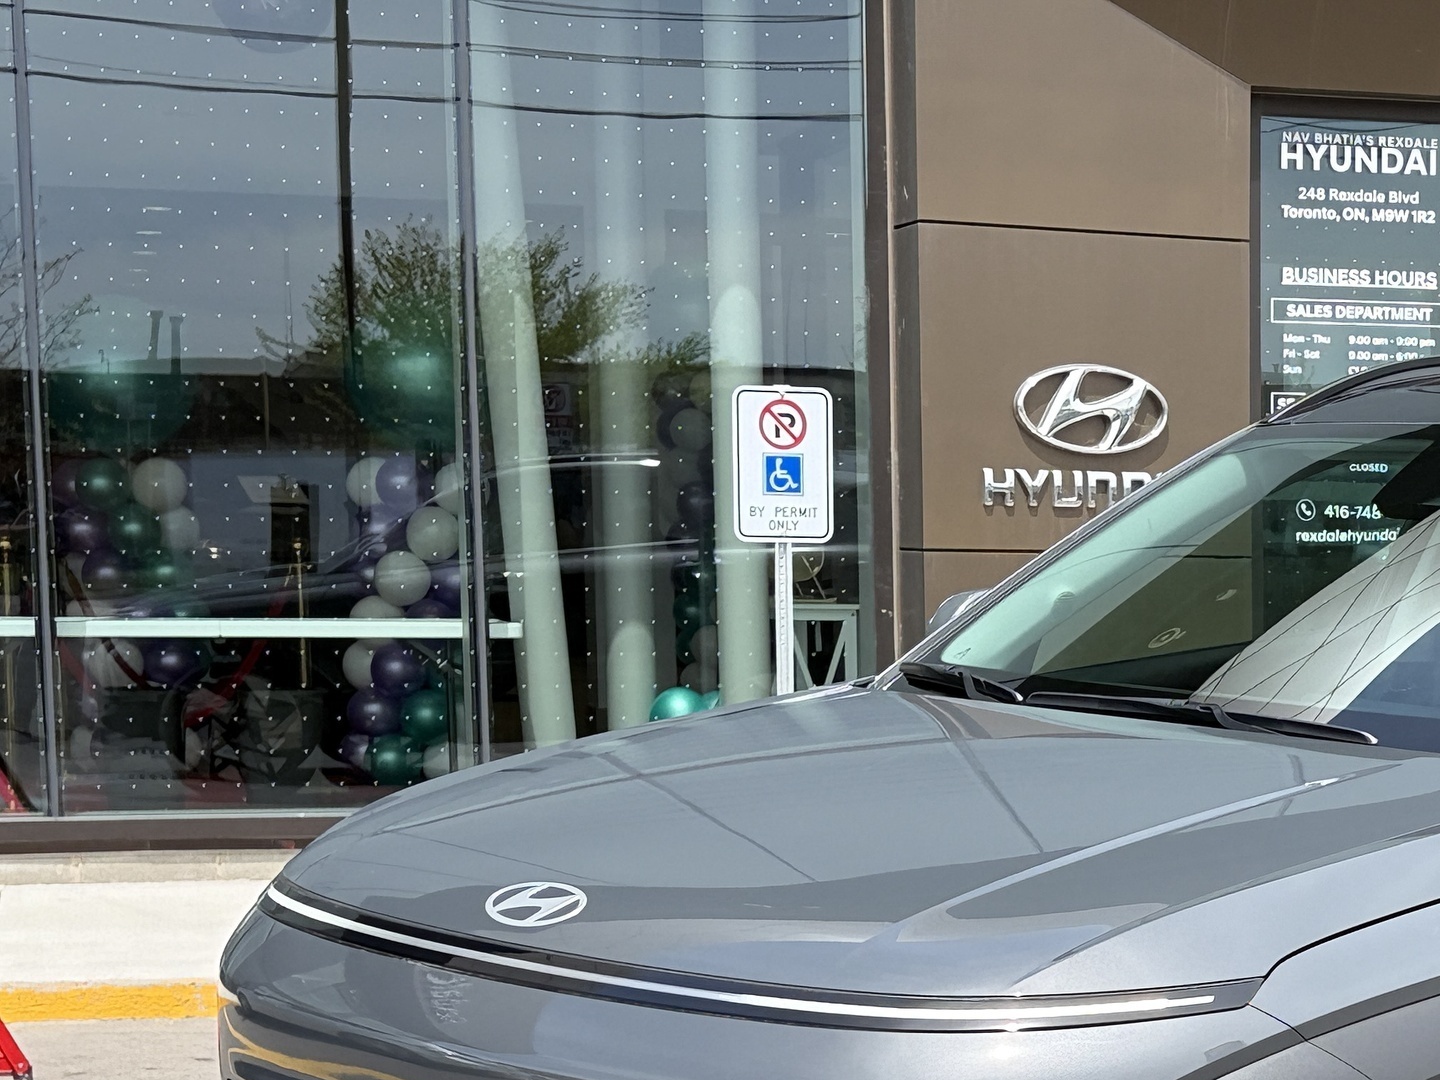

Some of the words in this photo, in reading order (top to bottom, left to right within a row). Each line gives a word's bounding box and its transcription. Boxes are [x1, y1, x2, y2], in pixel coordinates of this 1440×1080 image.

[1282, 131, 1310, 143] NAV
[1314, 133, 1375, 147] BHATIA'S
[1378, 136, 1439, 149] REXDALE
[1280, 143, 1438, 176] HYUNDAI
[1298, 187, 1326, 201] 248
[1329, 189, 1386, 204] Rexdale
[1388, 190, 1420, 205] Blvd
[1281, 205, 1341, 222] Toronto,
[1342, 209, 1370, 224] ON,
[1411, 210, 1436, 224] 1R2
[1281, 266, 1371, 285] BUSINESS
[1374, 270, 1438, 288] HOURS
[1286, 303, 1333, 319] SALES
[1335, 304, 1433, 322] DEPARTMENT
[1312, 334, 1331, 344] Thu
[1283, 349, 1296, 359] Fri
[1303, 349, 1321, 359] Sat
[1283, 364, 1302, 375] Sun
[1349, 463, 1389, 473] CLOSED
[983, 467, 1153, 508] HYUND
[750, 506, 765, 517] BY
[775, 507, 818, 518] PERMIT
[769, 520, 799, 531] ONLY
